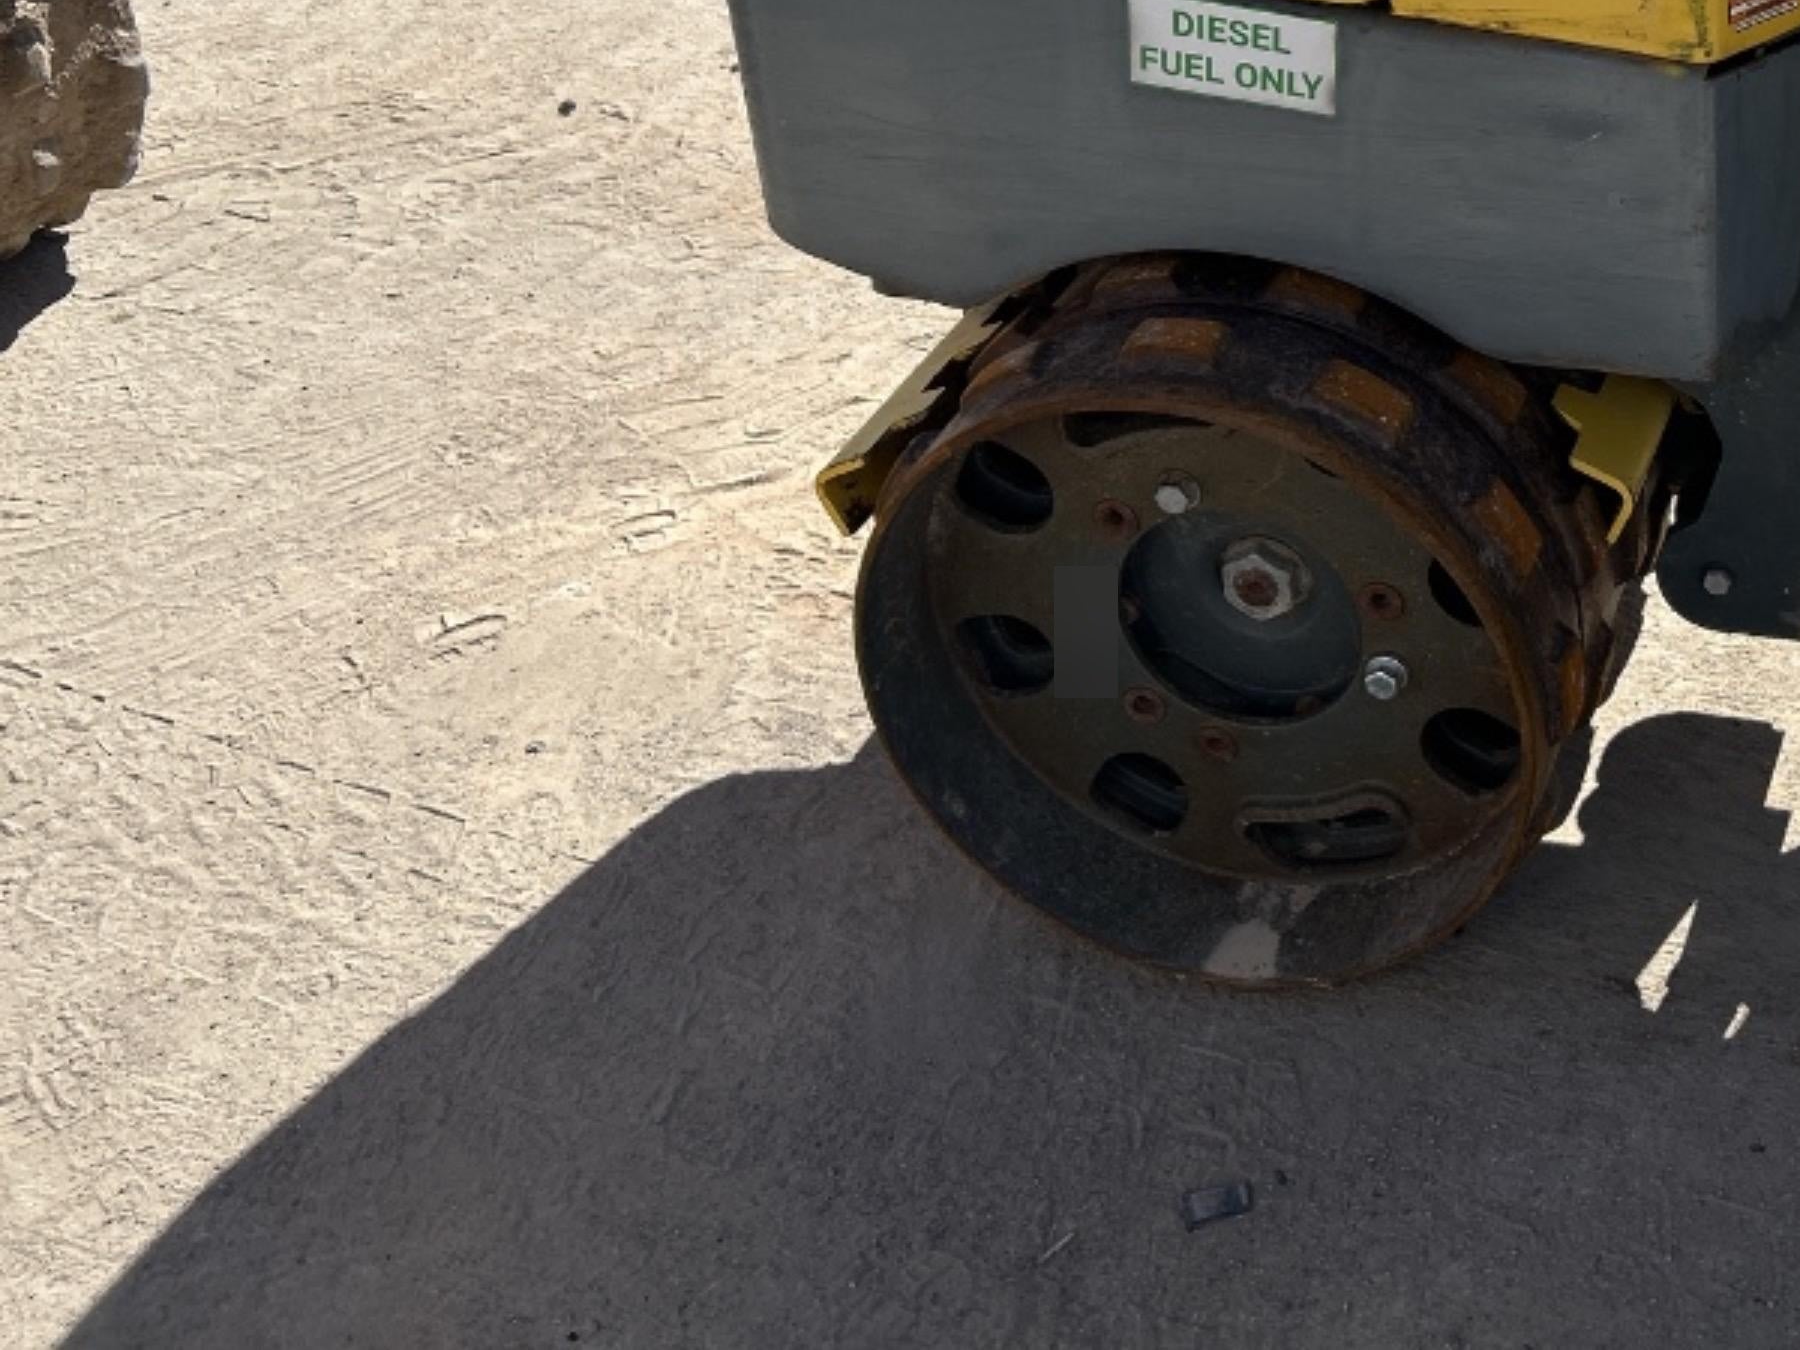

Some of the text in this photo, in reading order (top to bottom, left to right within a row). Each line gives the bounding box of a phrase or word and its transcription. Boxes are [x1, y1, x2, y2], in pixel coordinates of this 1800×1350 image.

[1171, 9, 1291, 56] DIESEL
[1139, 45, 1324, 101] FUEL ONLY
